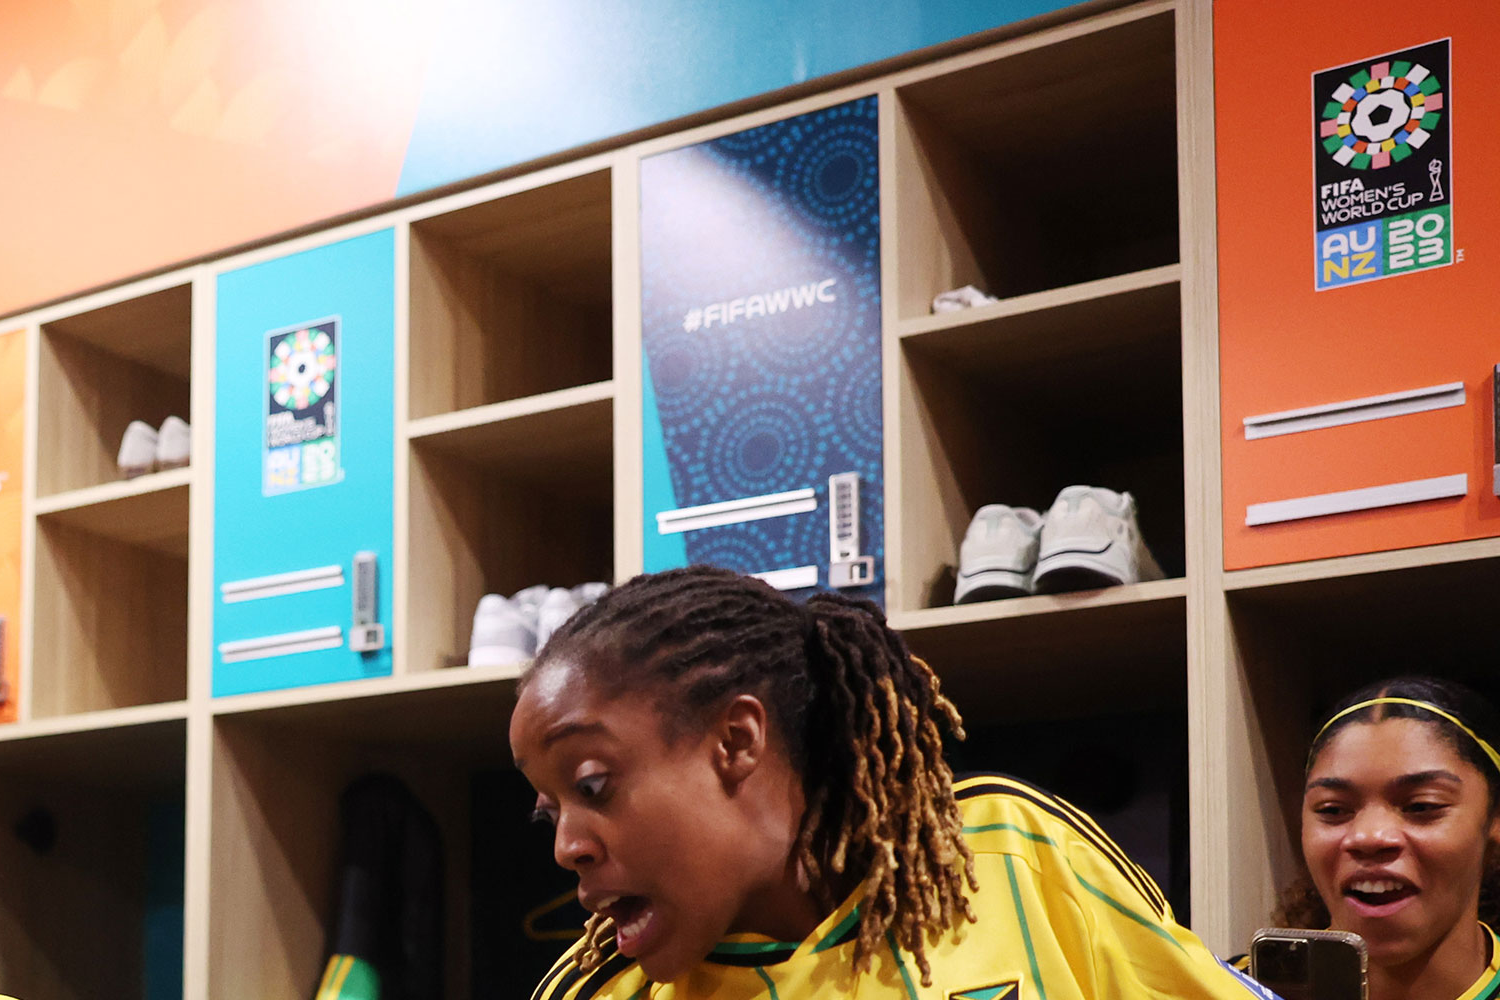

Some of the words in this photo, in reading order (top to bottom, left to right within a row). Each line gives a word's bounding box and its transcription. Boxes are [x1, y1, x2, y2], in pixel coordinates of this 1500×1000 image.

[1321, 177, 1365, 199] FIFA
[1322, 182, 1406, 212] WOMEN'S
[1322, 201, 1385, 225] WORLD
[1386, 192, 1423, 210] CUP
[1322, 226, 1376, 259] AU
[1389, 213, 1445, 245] 20
[1323, 250, 1376, 283] NZ
[1389, 237, 1444, 270] 23
[682, 278, 836, 334] #FIFAWWC
